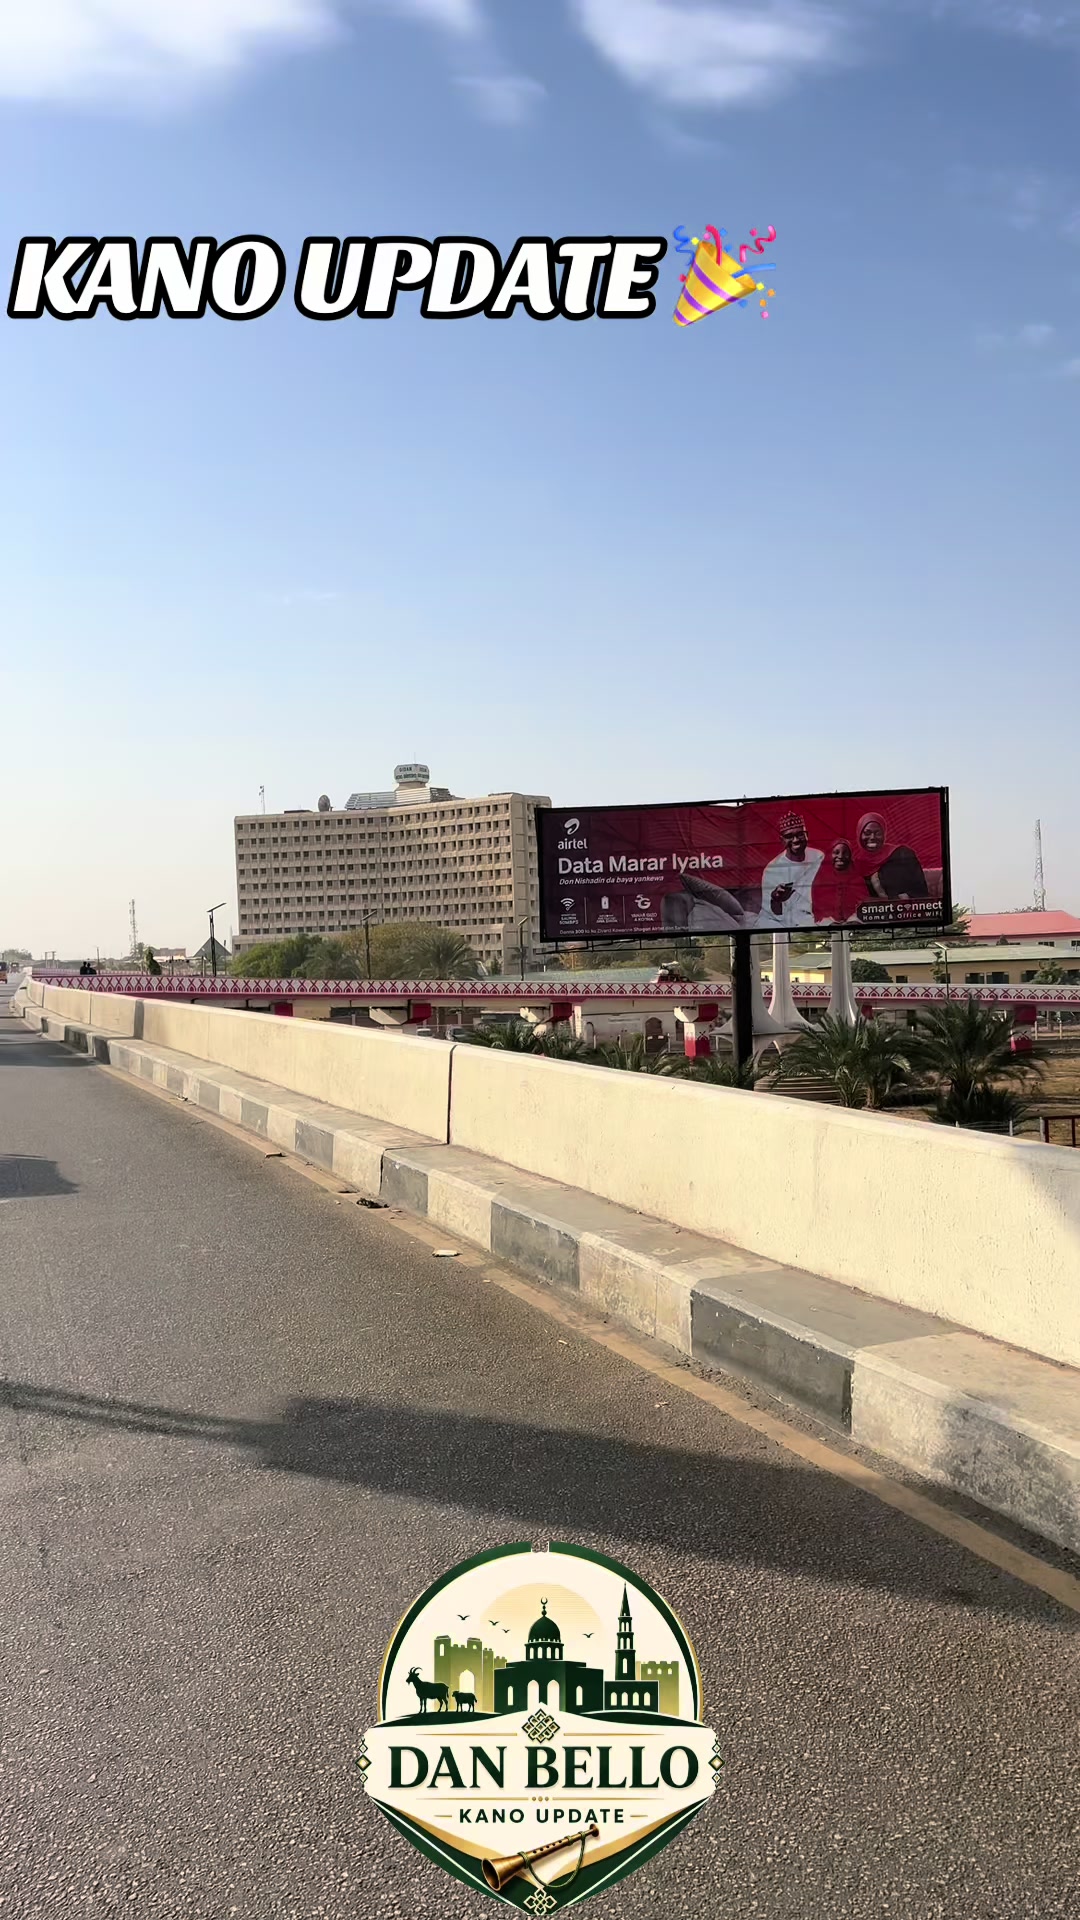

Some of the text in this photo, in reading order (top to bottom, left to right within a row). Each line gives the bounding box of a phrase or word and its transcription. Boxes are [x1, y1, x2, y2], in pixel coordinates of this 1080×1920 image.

[557, 838, 588, 850] airtel
[558, 852, 723, 874] Data Marar Iyaka
[574, 877, 605, 885] Nishadin
[606, 876, 615, 884] da
[616, 876, 633, 885] baya
[634, 875, 664, 884] yankewa
[861, 904, 894, 914] smart
